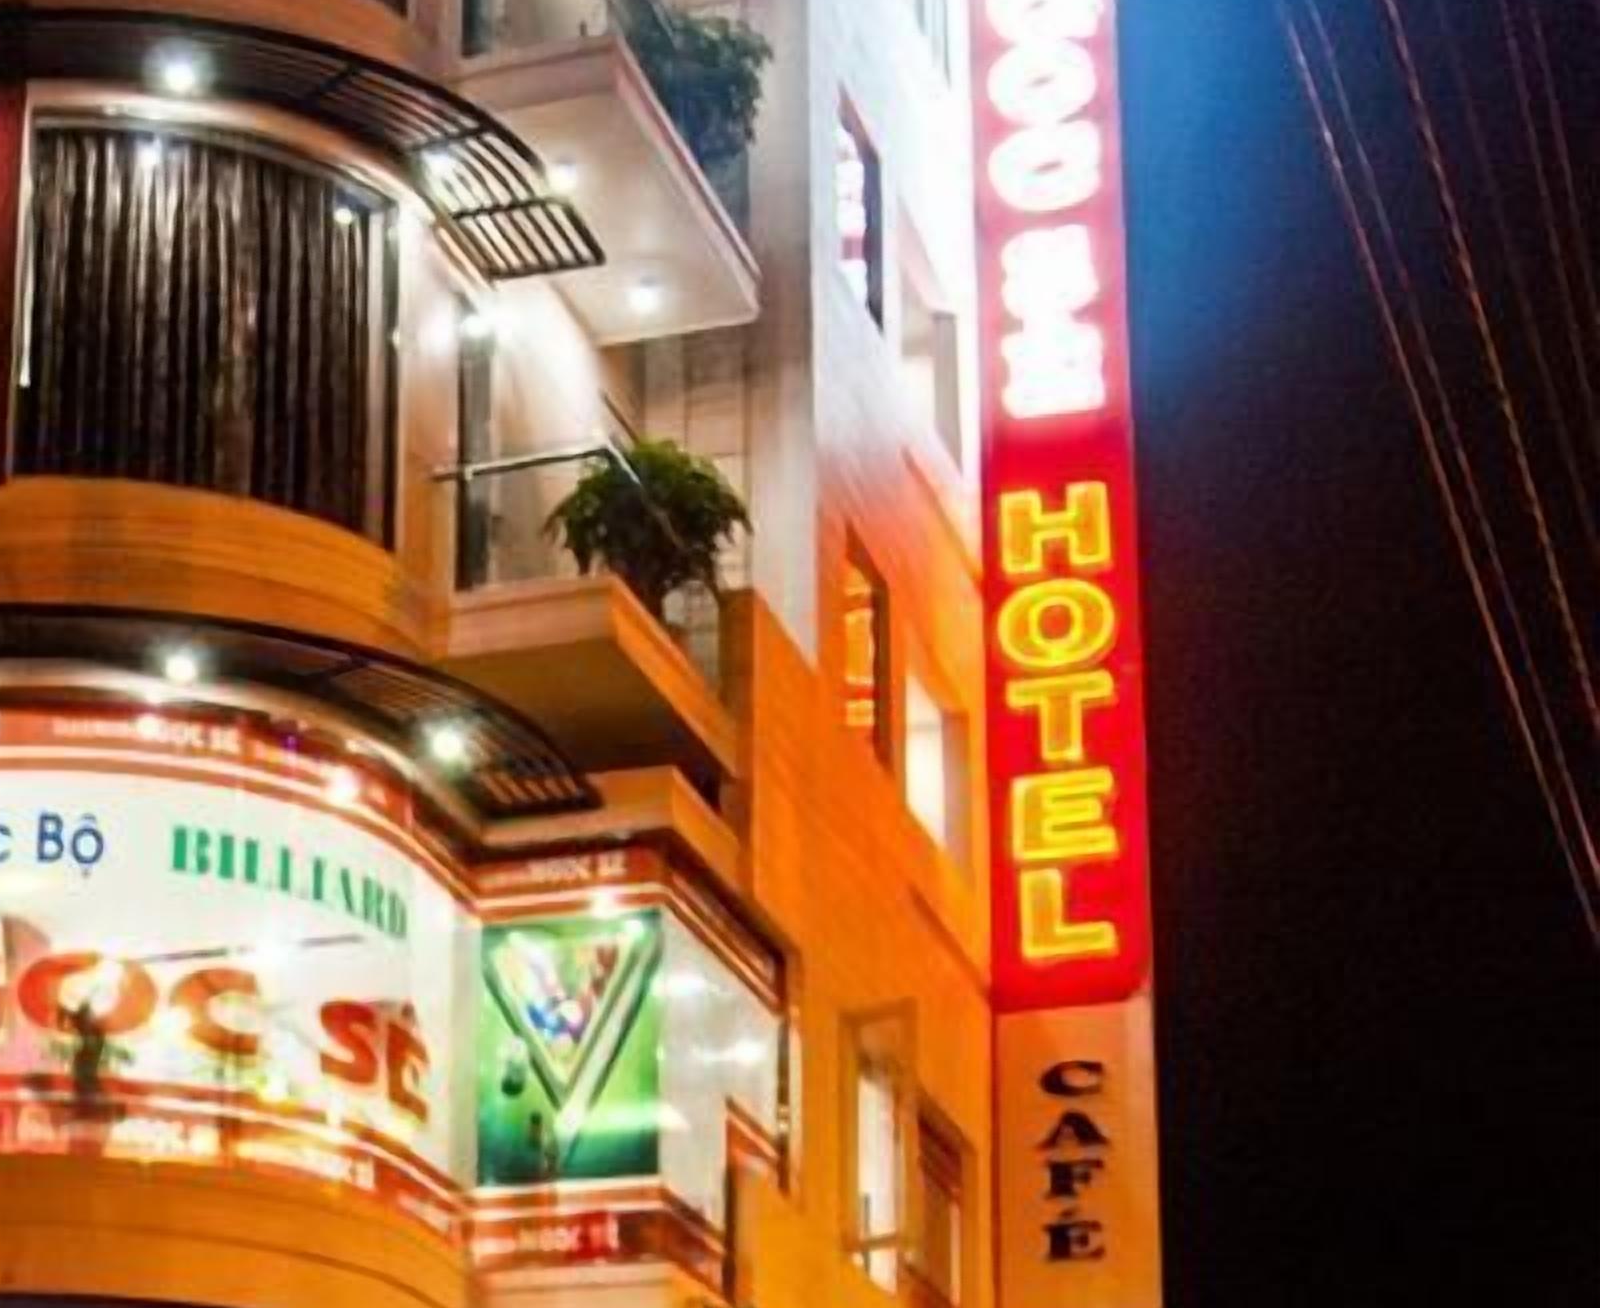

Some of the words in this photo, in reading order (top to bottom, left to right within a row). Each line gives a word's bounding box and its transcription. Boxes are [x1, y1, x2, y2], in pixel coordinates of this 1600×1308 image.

[997, 480, 1119, 962] HOTEL
[37, 810, 105, 880] Bộ
[170, 824, 408, 940] BILLIARD
